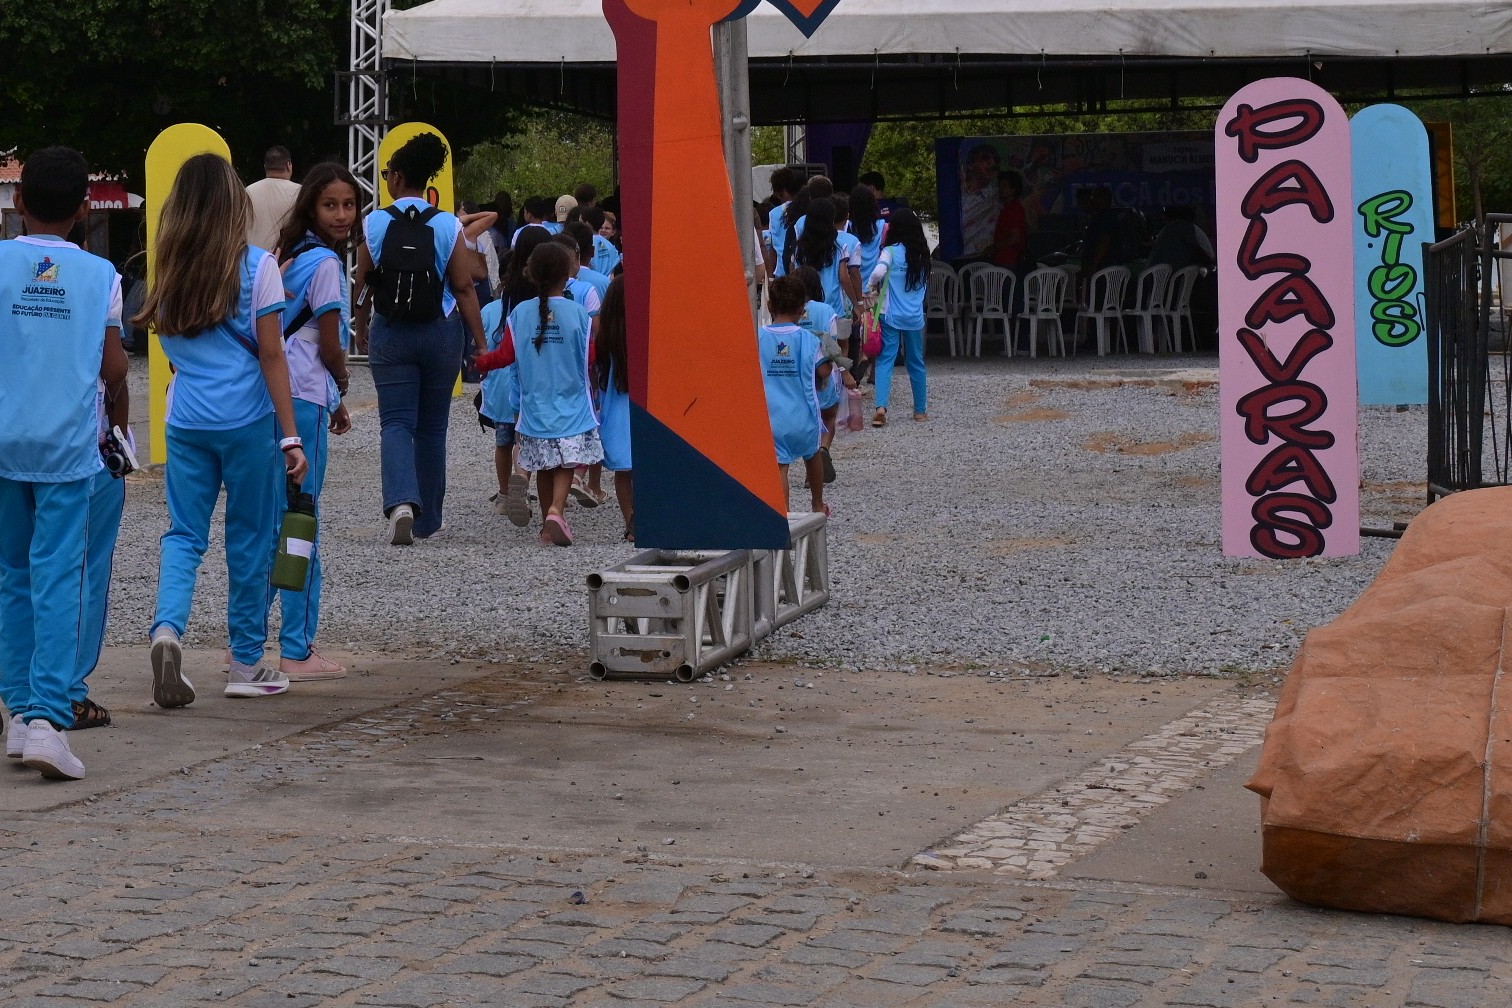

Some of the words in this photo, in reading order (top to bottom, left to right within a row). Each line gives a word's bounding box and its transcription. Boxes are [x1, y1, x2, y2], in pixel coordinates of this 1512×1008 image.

[12, 304, 43, 312] EDUCAÇÃO
[43, 306, 71, 314] PRESENTE
[22, 286, 66, 296] JUAZEIRO
[1358, 190, 1421, 347] RIOS
[1225, 98, 1336, 559] PALAVRAS
